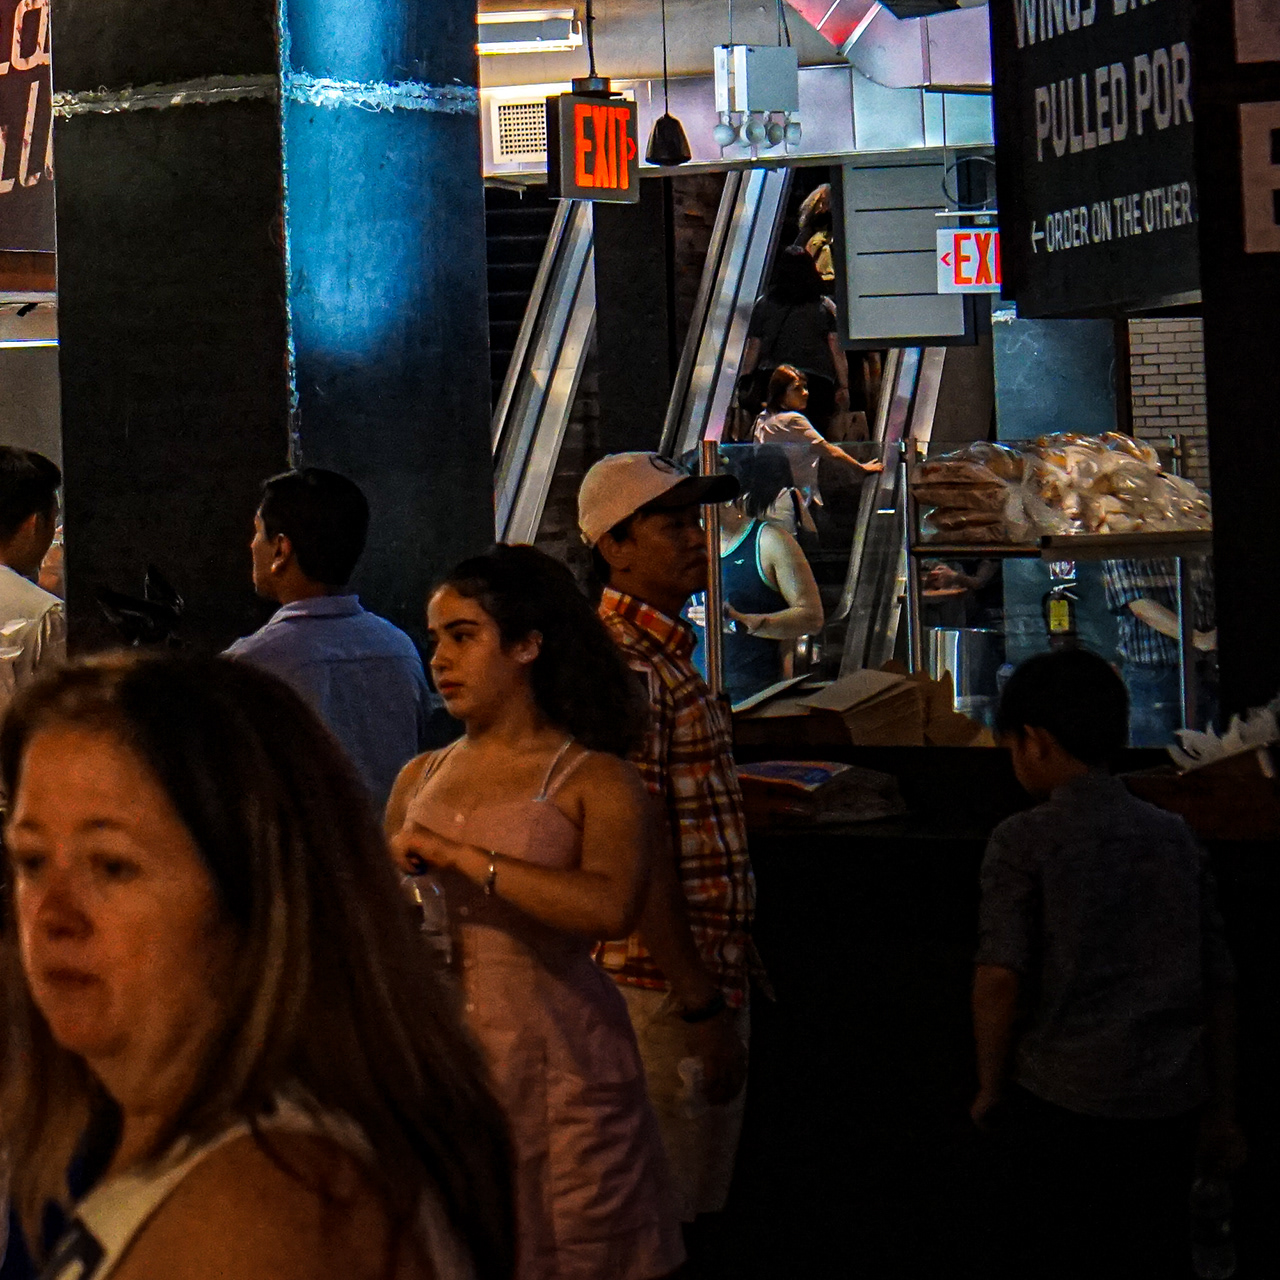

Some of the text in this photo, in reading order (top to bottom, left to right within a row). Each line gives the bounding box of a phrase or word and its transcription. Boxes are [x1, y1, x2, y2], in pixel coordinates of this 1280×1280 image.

[575, 103, 629, 189] EXIT
[1035, 61, 1129, 163] PULLED
[1045, 181, 1193, 252] ORDER ON THE OTHER
